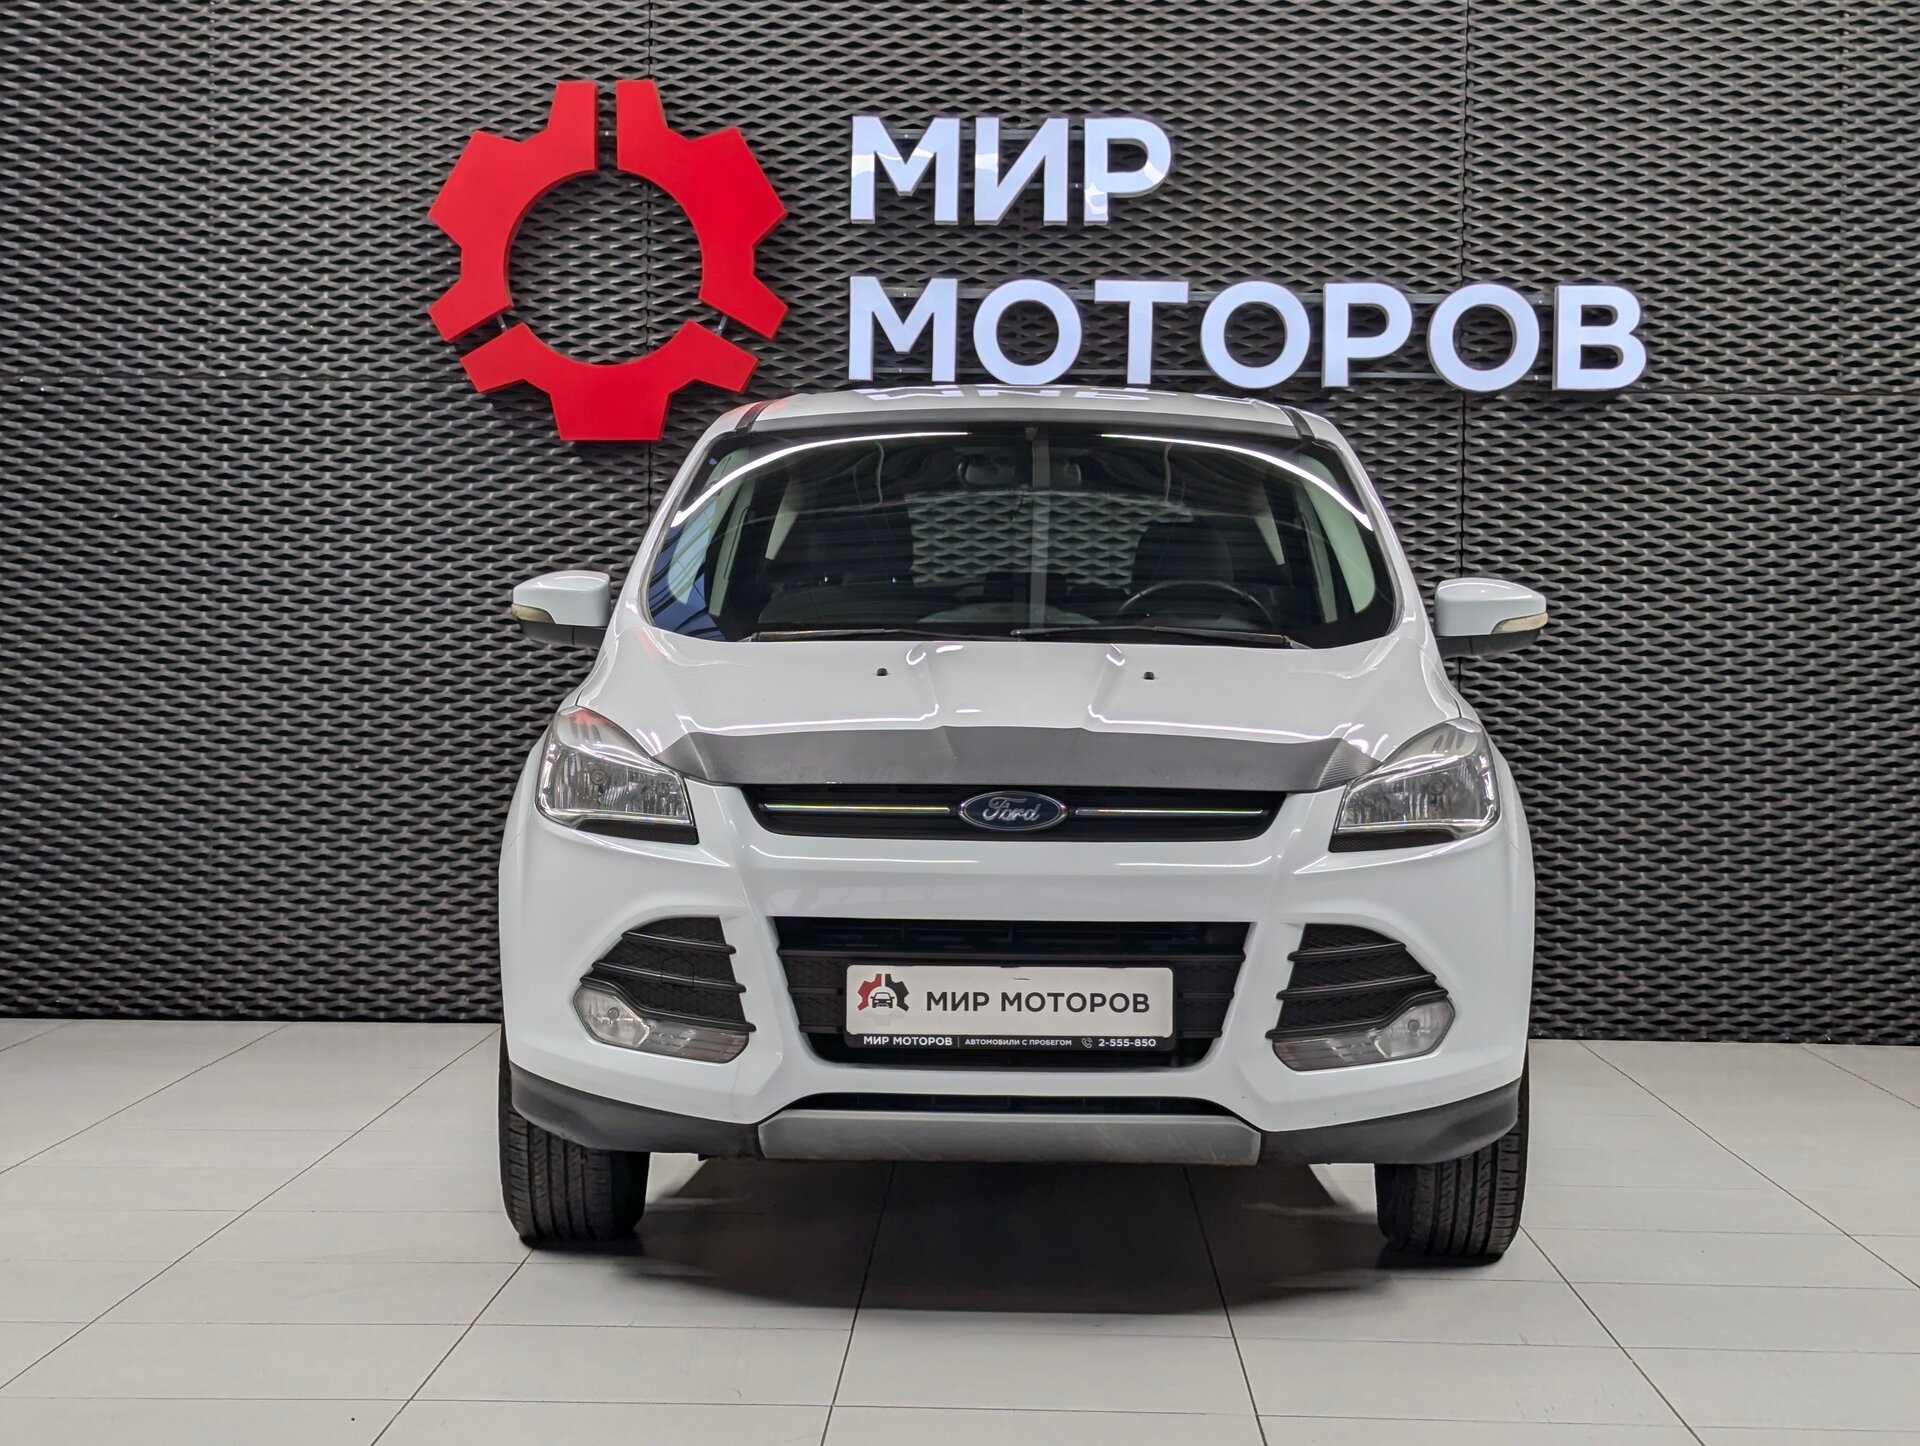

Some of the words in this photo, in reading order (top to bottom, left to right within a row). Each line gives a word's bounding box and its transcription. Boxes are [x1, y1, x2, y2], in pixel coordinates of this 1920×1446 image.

[850, 115, 1172, 226] МИР
[847, 276, 1647, 391] МОТОРОВ
[982, 796, 1041, 822] Ford
[926, 991, 990, 1012] МИР
[1000, 991, 1150, 1013] МОТОРОВ
[863, 1035, 889, 1045] МИР
[893, 1036, 953, 1046] МОТОРОВ
[964, 1038, 1020, 1046] АВТОМОБИЛИ
[1029, 1039, 1072, 1047] ПРОБЕГОМ
[1098, 1038, 1157, 1047] 2-555-850
